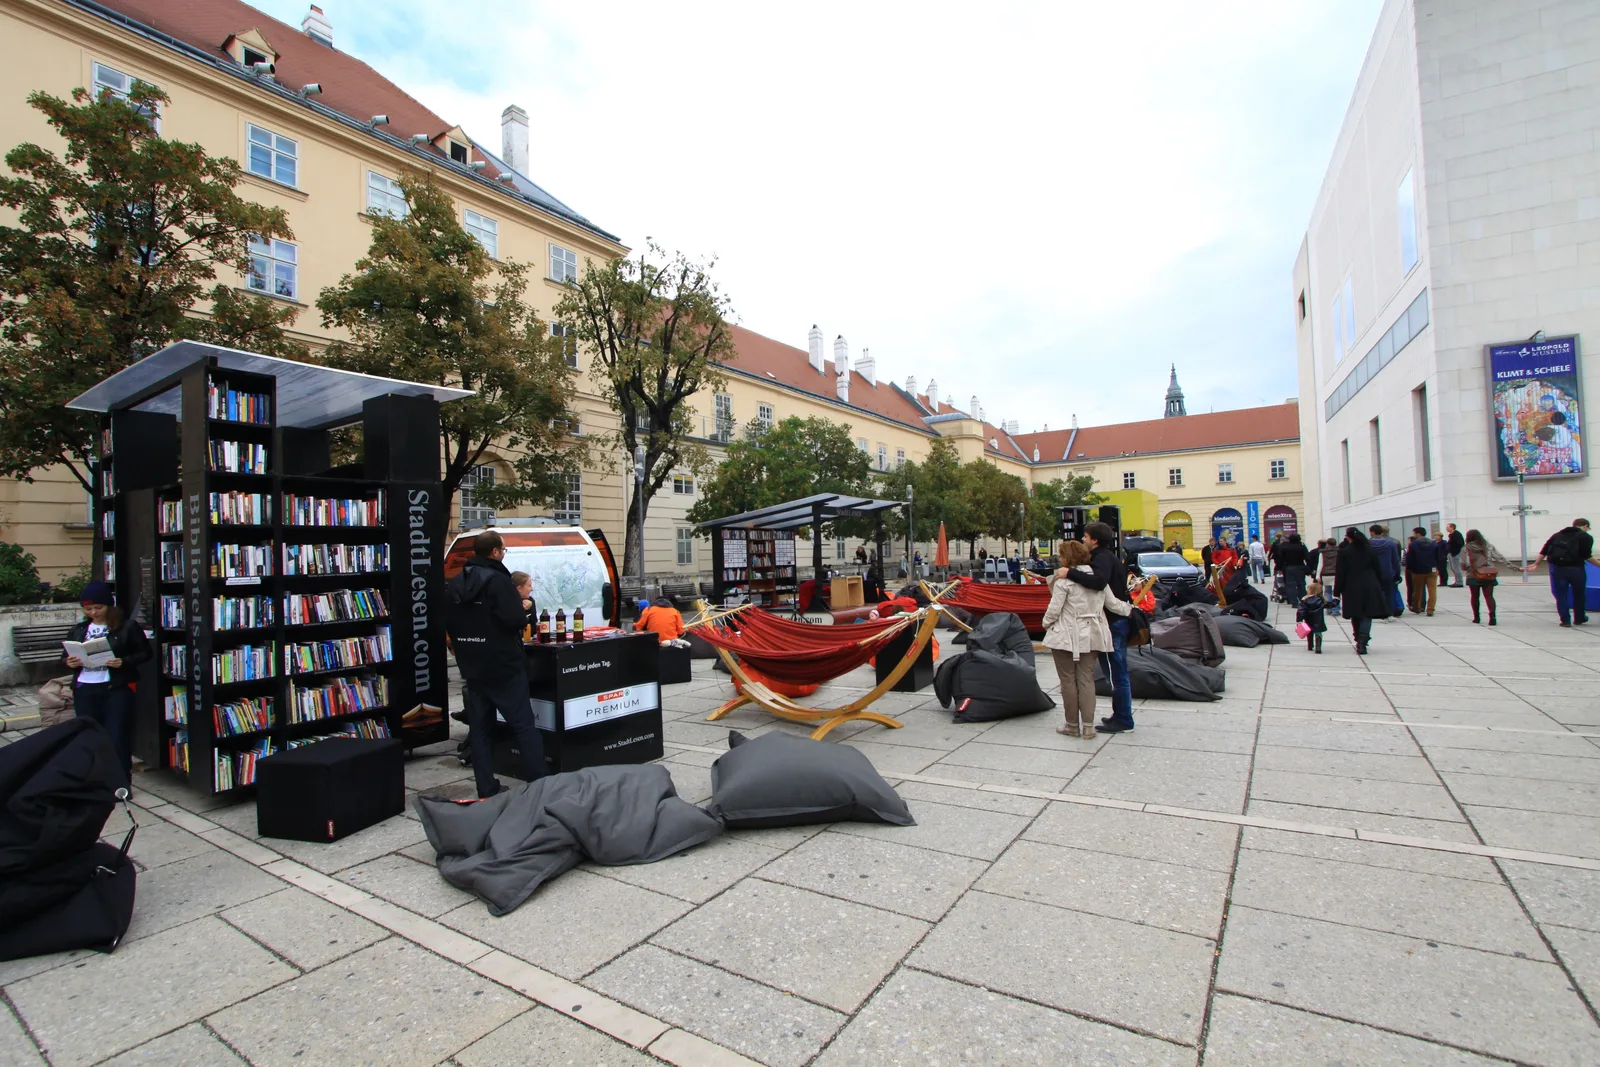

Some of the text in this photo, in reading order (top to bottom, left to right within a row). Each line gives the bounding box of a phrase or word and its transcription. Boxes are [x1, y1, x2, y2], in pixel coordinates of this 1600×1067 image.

[1531, 348, 1570, 357] MUSEUM
[1532, 343, 1569, 351] LEOPOLD
[1497, 369, 1524, 378] KLIMT
[1534, 364, 1571, 375] SCHIELE
[407, 489, 432, 694] StadtLesen.com
[563, 666, 578, 674] Luxus
[587, 662, 600, 671] jeden
[601, 660, 611, 668] Tag.
[603, 691, 623, 701] SPAR
[586, 698, 640, 718] PREMIUM
[604, 732, 655, 751] www.StadtLesen.com
